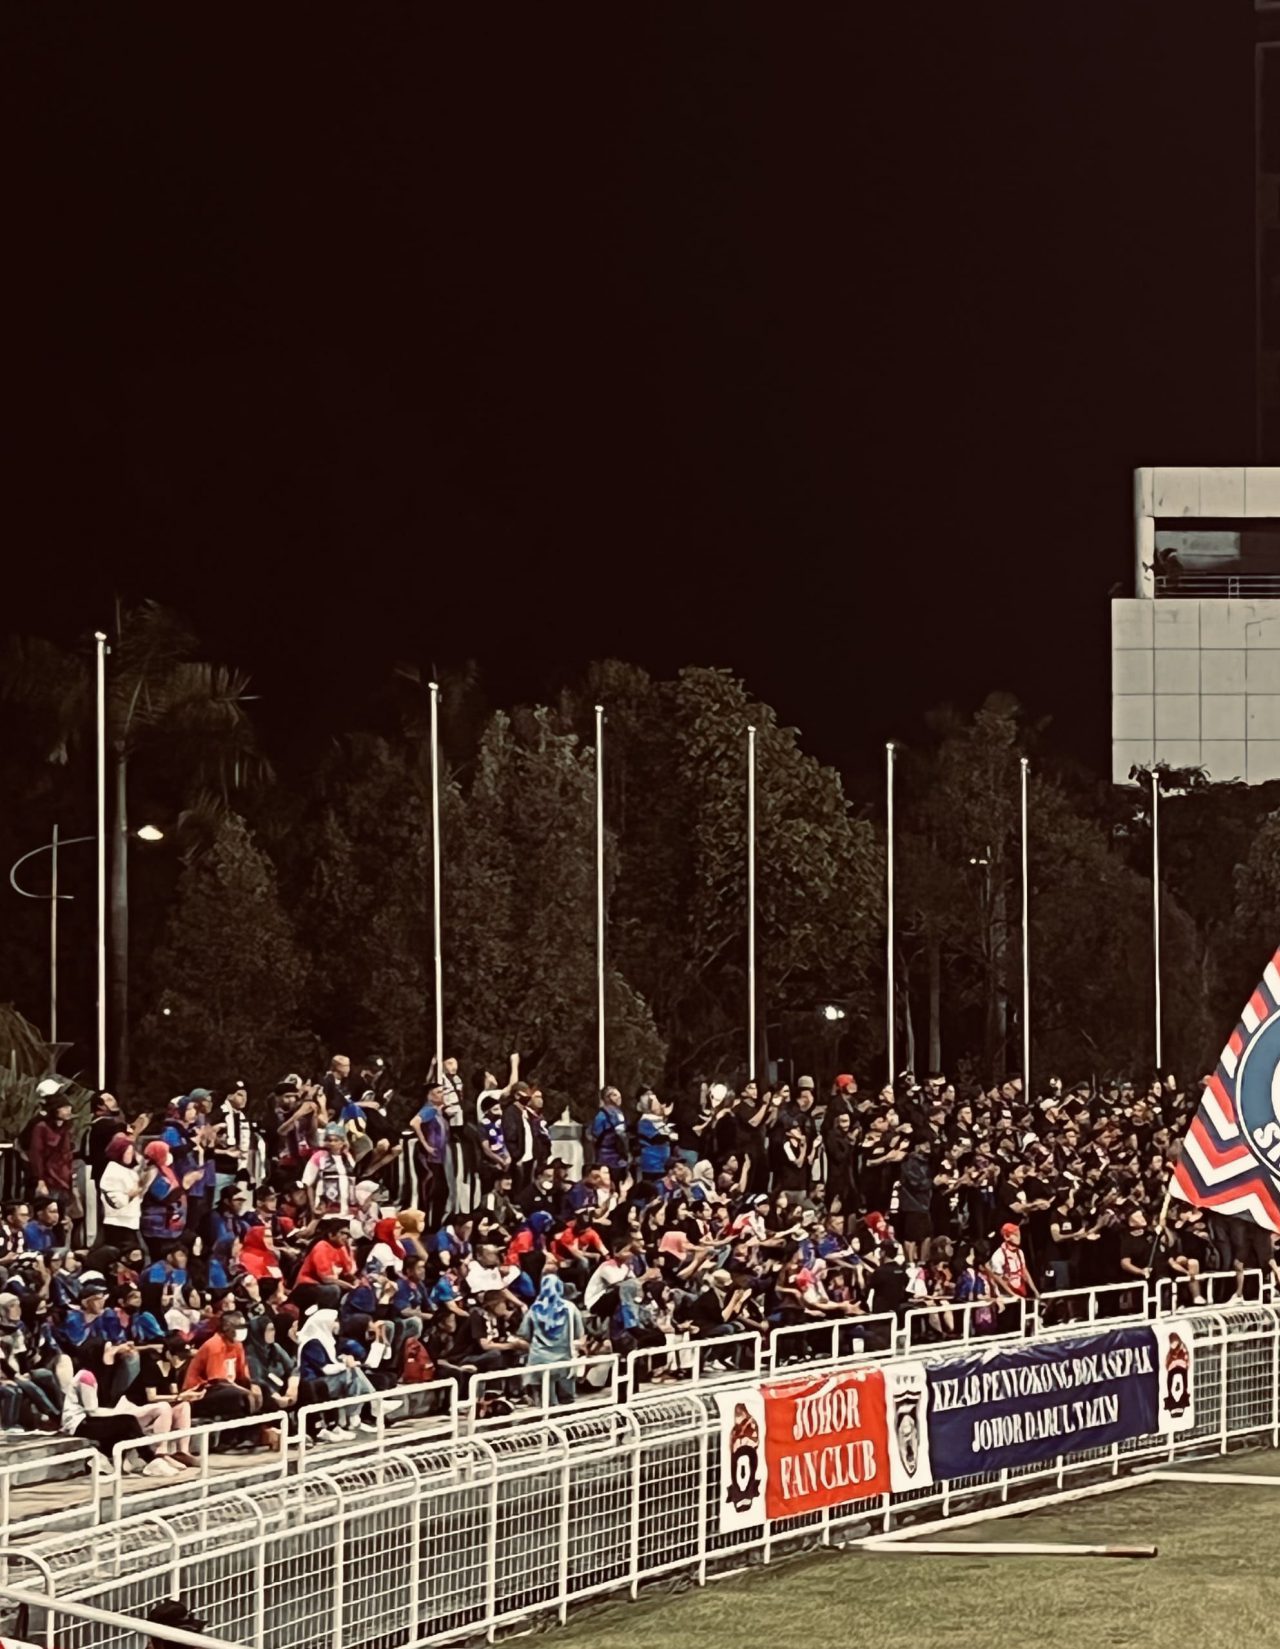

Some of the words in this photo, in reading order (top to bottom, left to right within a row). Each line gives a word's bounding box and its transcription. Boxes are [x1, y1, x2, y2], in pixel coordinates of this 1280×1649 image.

[792, 1388, 861, 1440] JOHOR
[971, 1411, 1025, 1453] JOHOR
[1025, 1402, 1076, 1441] DARUL
